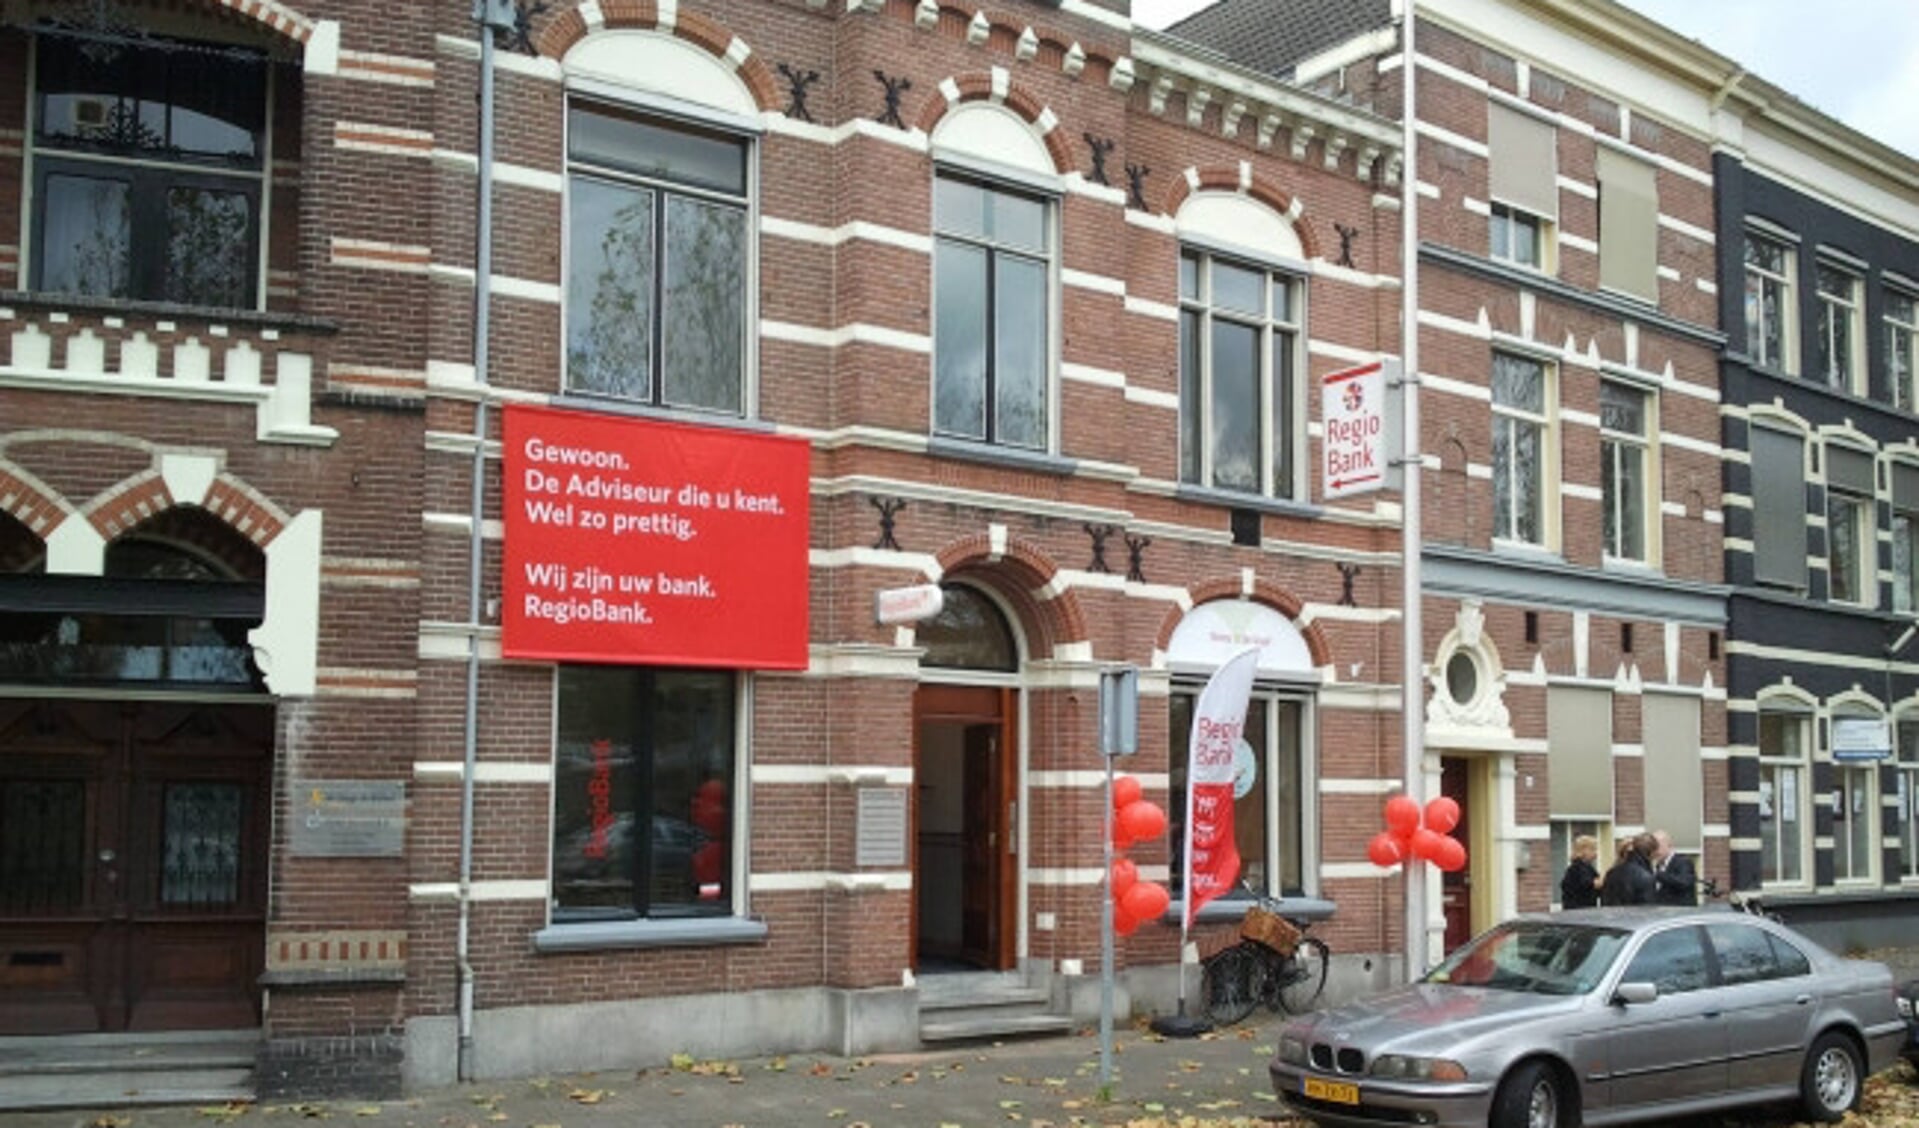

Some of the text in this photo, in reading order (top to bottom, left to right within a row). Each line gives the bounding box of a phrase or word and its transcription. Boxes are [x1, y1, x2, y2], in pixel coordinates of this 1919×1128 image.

[1327, 409, 1380, 446] Regio
[524, 438, 629, 470] Gewoon.
[1327, 442, 1374, 476] Bank
[524, 469, 784, 515] De Adviseur die u kent.
[525, 501, 698, 541] Wel zo prettig.
[525, 563, 717, 598] Wij zijn uw bank.
[524, 594, 653, 624] RegioBank.
